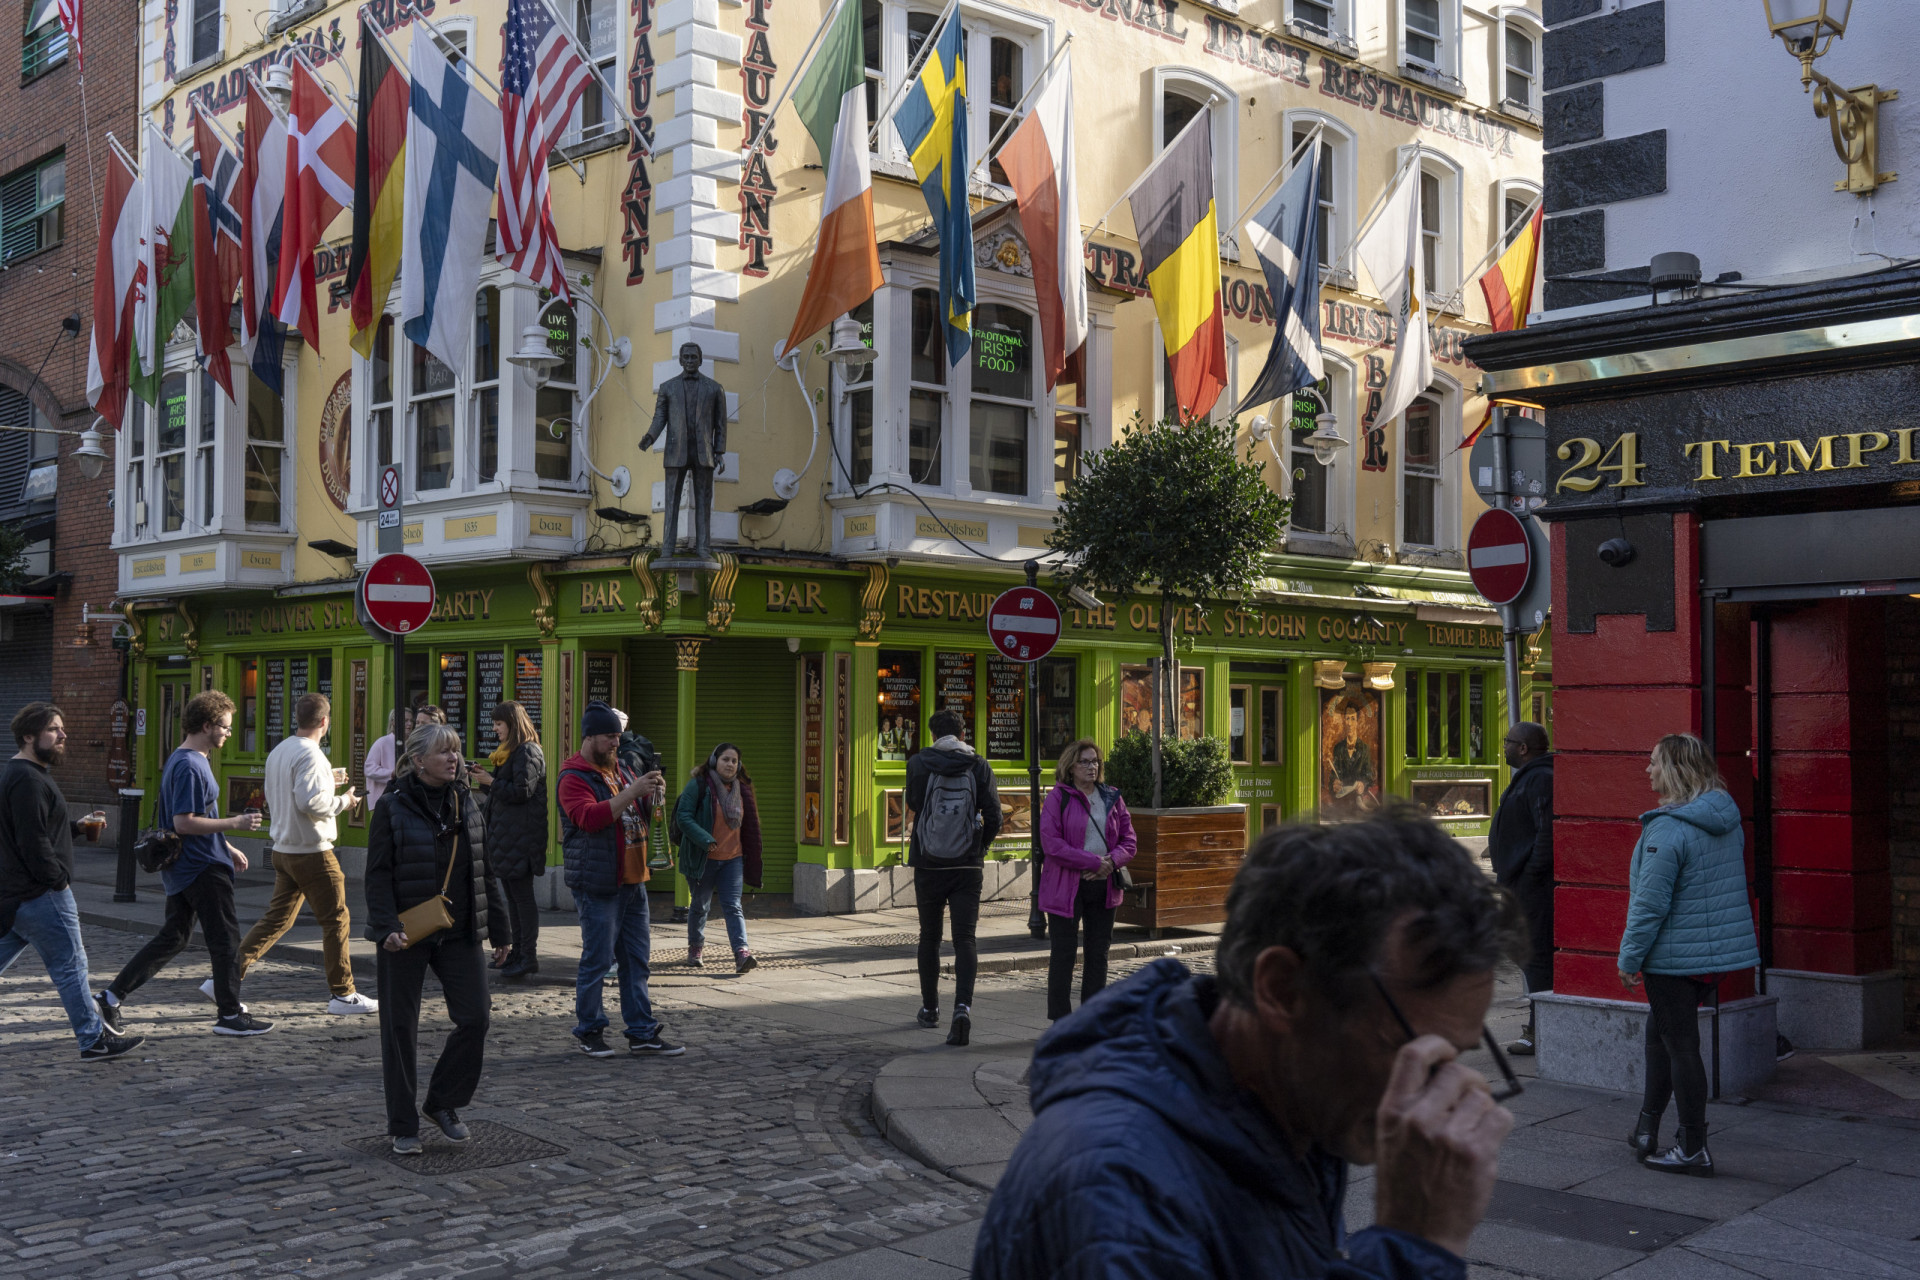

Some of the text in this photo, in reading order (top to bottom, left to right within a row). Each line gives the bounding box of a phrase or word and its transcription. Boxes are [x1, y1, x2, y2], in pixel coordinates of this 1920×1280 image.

[1203, 13, 1310, 89] IRISH
[1319, 56, 1519, 159] RESTAURANT
[548, 314, 568, 326] LIVE
[549, 329, 569, 341] RISH
[972, 328, 1023, 348] TRADITIONAL
[551, 346, 573, 357] USIC
[980, 341, 1013, 358] IRISH
[979, 355, 1015, 373] FOOD
[1292, 400, 1317, 414] IRISH
[1362, 354, 1389, 472] BAR
[1555, 432, 1647, 494] 24
[380, 514, 390, 526] 24
[430, 588, 495, 621] GARTY
[580, 580, 626, 613] BAR
[765, 580, 828, 614] BAR
[897, 584, 998, 621] RESTAUR
[159, 613, 175, 641] 57
[225, 608, 254, 636] THE
[260, 603, 316, 633] OLIVER
[324, 600, 347, 630] ST.
[1129, 603, 1212, 636] OLVER
[1223, 608, 1254, 637] ST.
[1257, 611, 1307, 641] JOHN
[1317, 615, 1410, 647] GOGARTY
[1425, 623, 1476, 648] TEMPLE
[1478, 628, 1504, 649] BAR
[996, 776, 1031, 785] RISH MUS
[1429, 770, 1444, 778] FOOD
[837, 771, 845, 815] AREA
